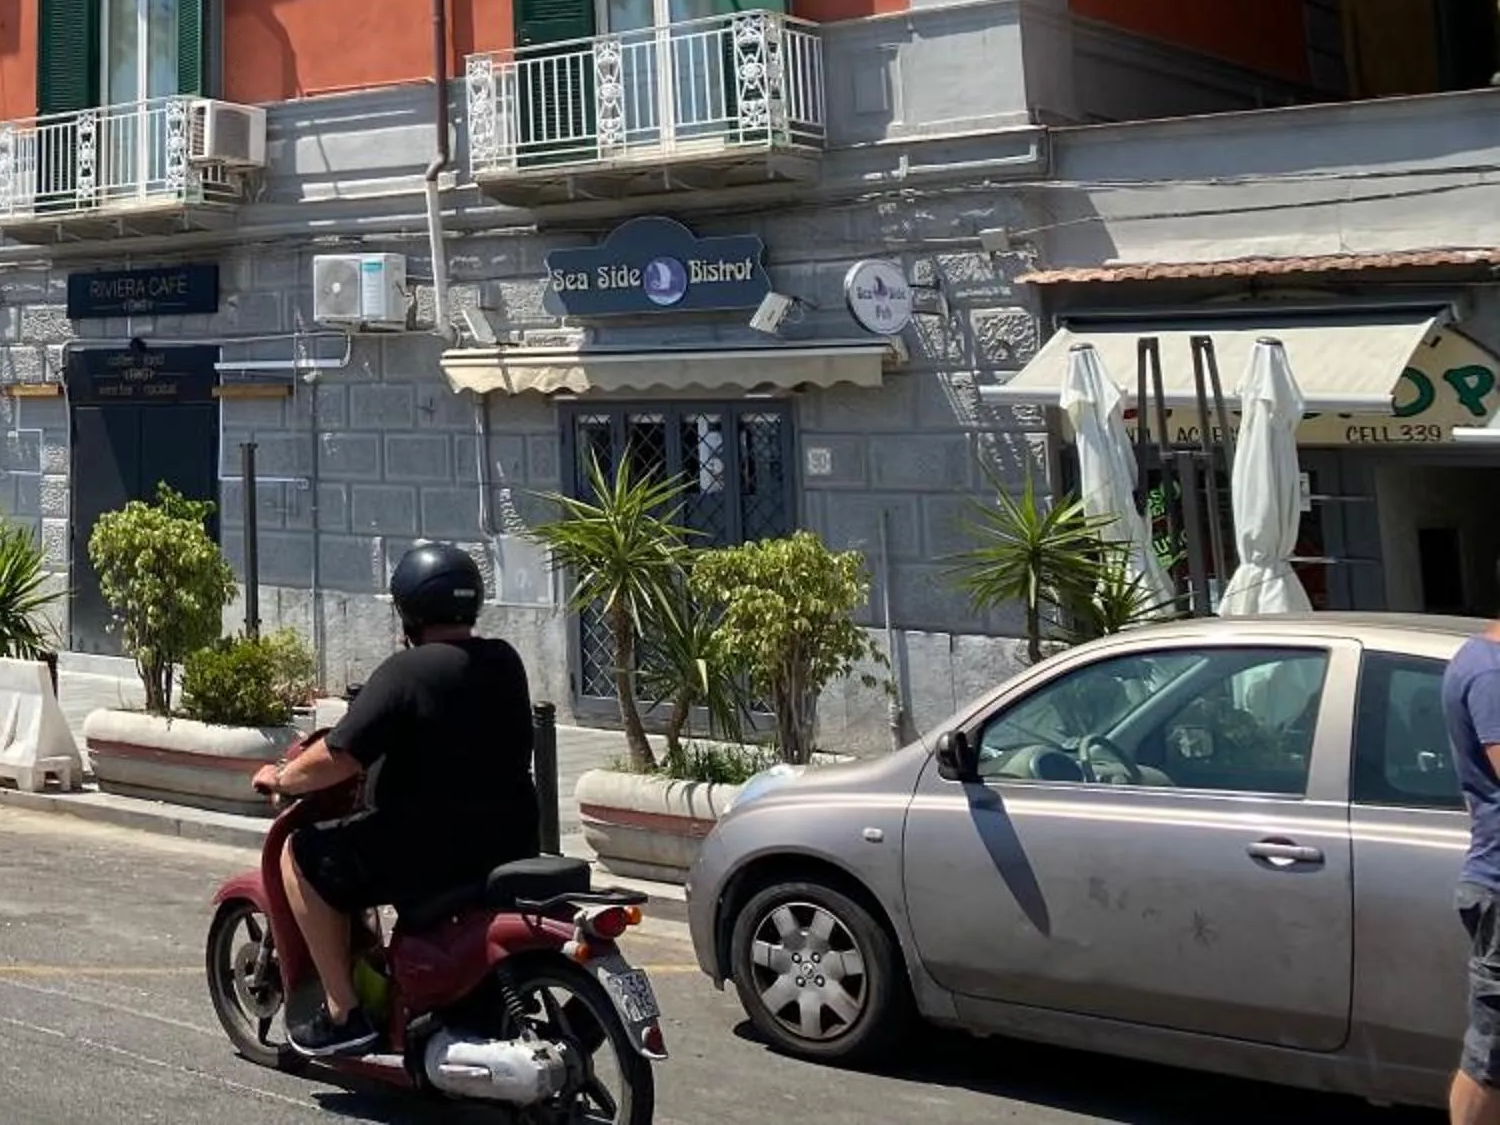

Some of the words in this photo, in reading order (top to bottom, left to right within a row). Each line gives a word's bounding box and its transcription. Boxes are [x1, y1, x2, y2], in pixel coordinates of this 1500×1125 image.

[552, 269, 589, 291] Sea
[596, 264, 642, 288] Side
[688, 257, 753, 284] Bistrot
[88, 277, 146, 300] RIVIERA
